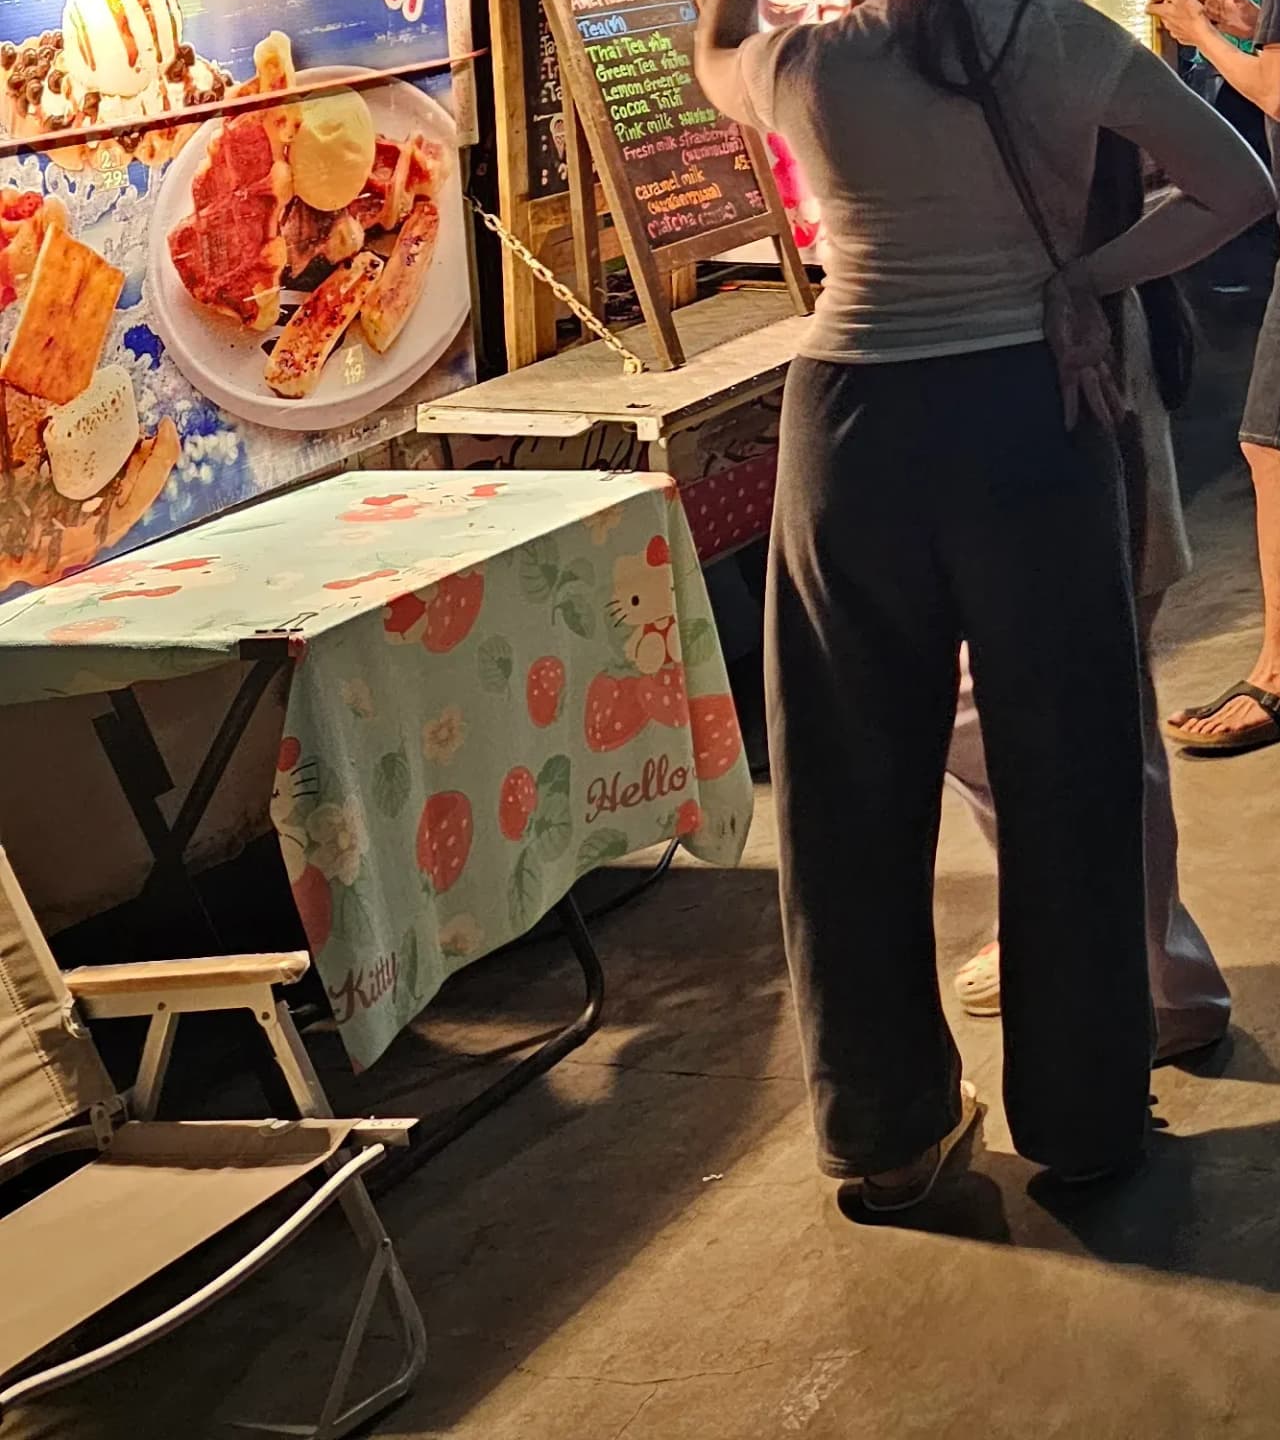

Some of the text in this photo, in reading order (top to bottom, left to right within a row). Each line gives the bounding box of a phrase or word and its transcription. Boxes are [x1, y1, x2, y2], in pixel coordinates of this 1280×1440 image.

[584, 40, 622, 63] Thai
[621, 36, 648, 57] Tea
[595, 60, 637, 83] Green
[633, 57, 659, 75] Tea
[602, 81, 644, 102] Lemon
[610, 99, 650, 121] Cocoa
[614, 122, 647, 143] Pink
[646, 112, 674, 133] milk
[680, 164, 705, 187] milk
[585, 753, 689, 824] Hello
[328, 951, 400, 1025] Kitty
